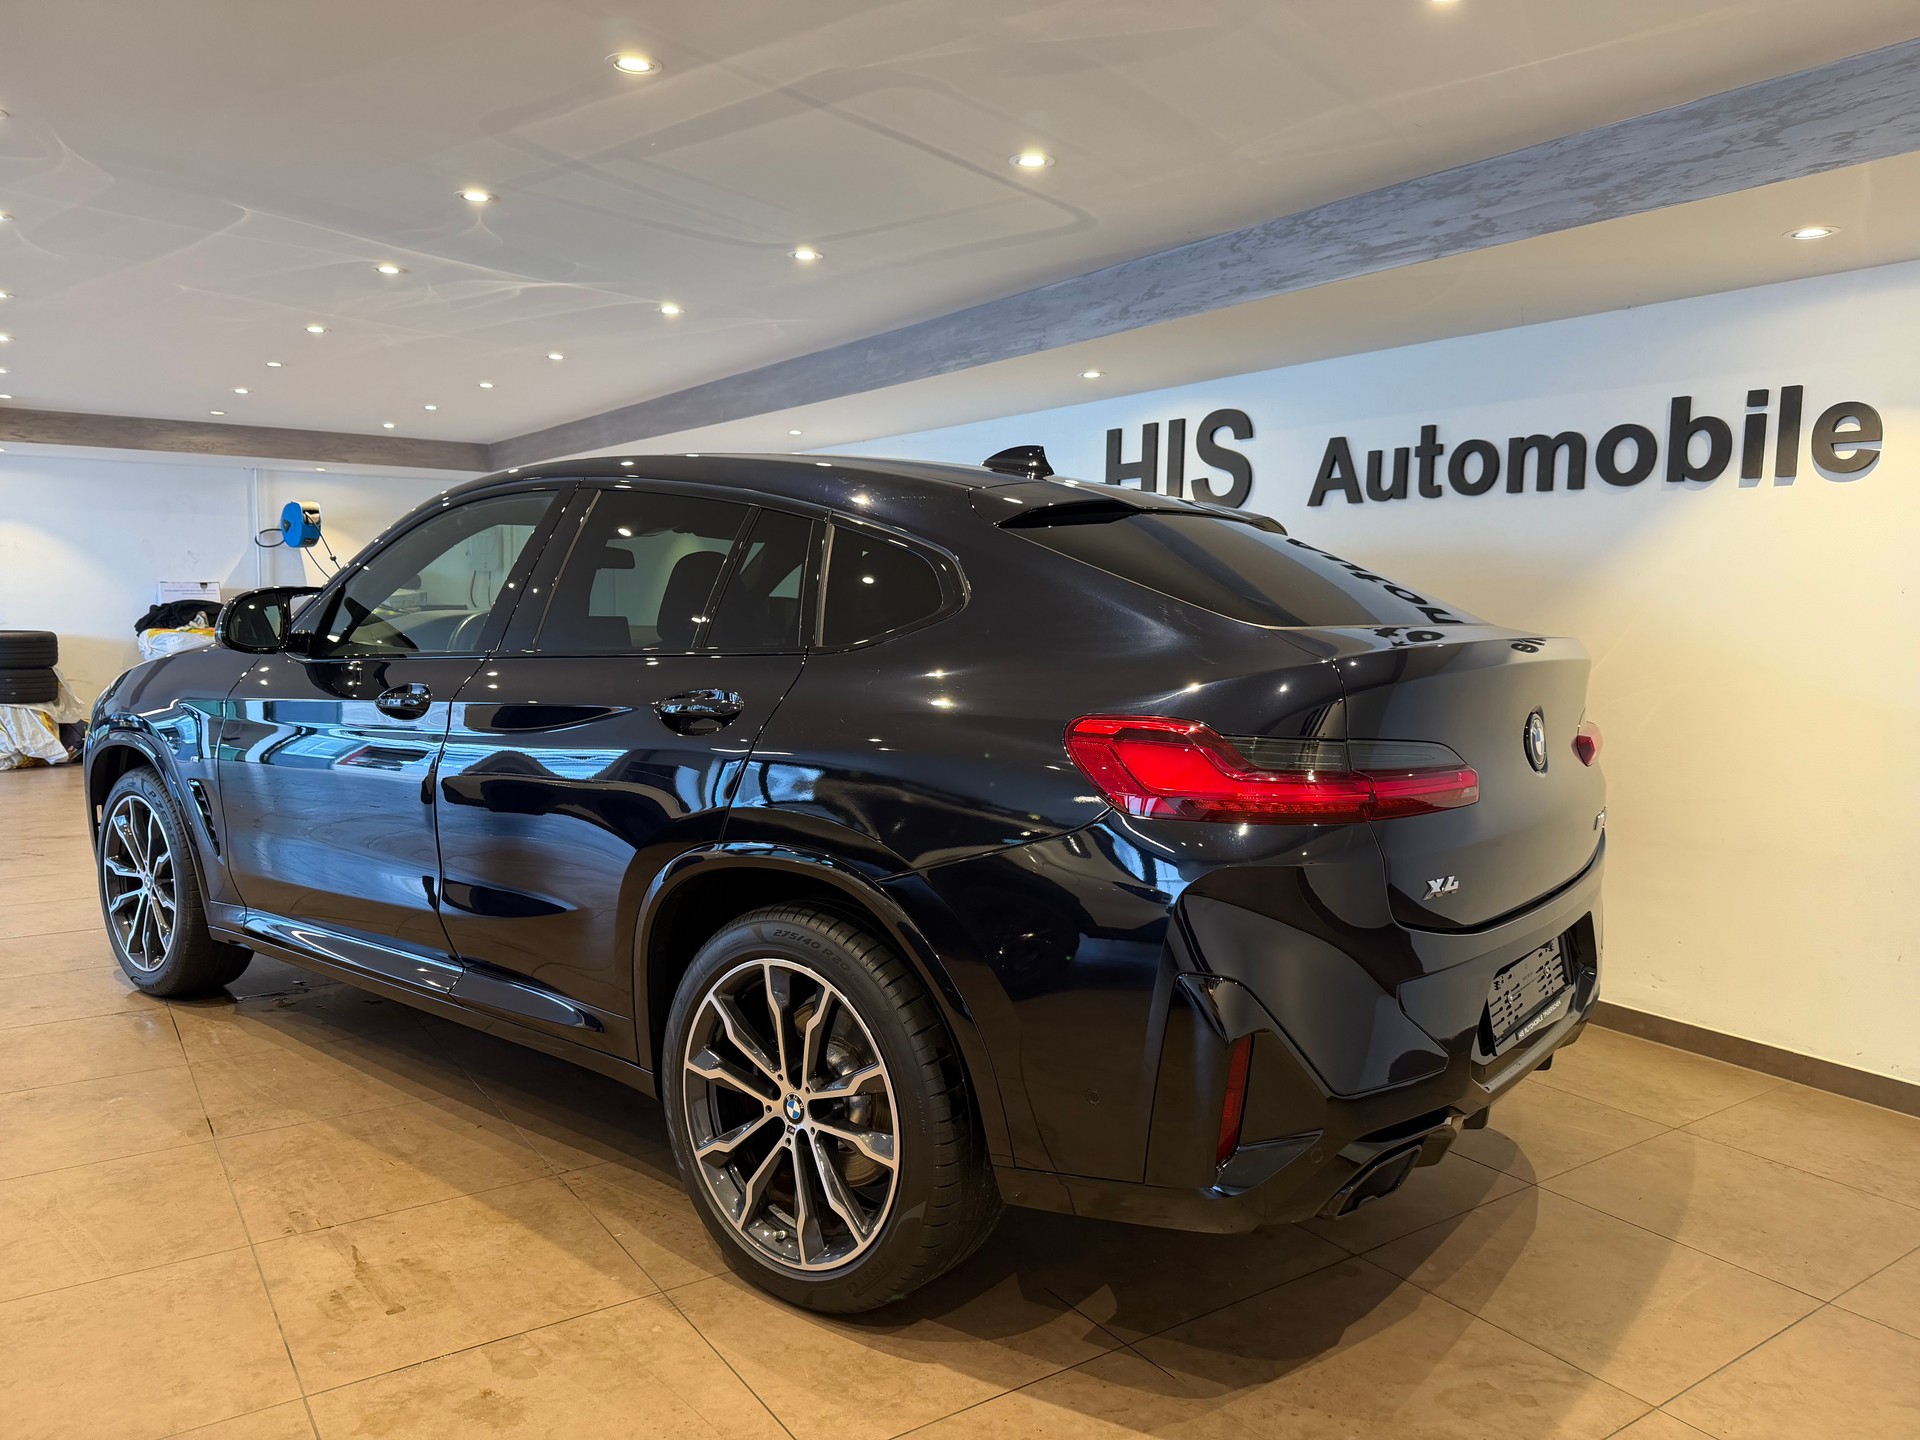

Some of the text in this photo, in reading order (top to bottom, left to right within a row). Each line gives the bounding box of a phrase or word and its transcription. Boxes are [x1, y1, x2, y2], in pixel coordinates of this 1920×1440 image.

[1105, 384, 1883, 508] HIS Automobile
[1422, 875, 1460, 901] X4
[772, 929, 821, 951] 275/40
